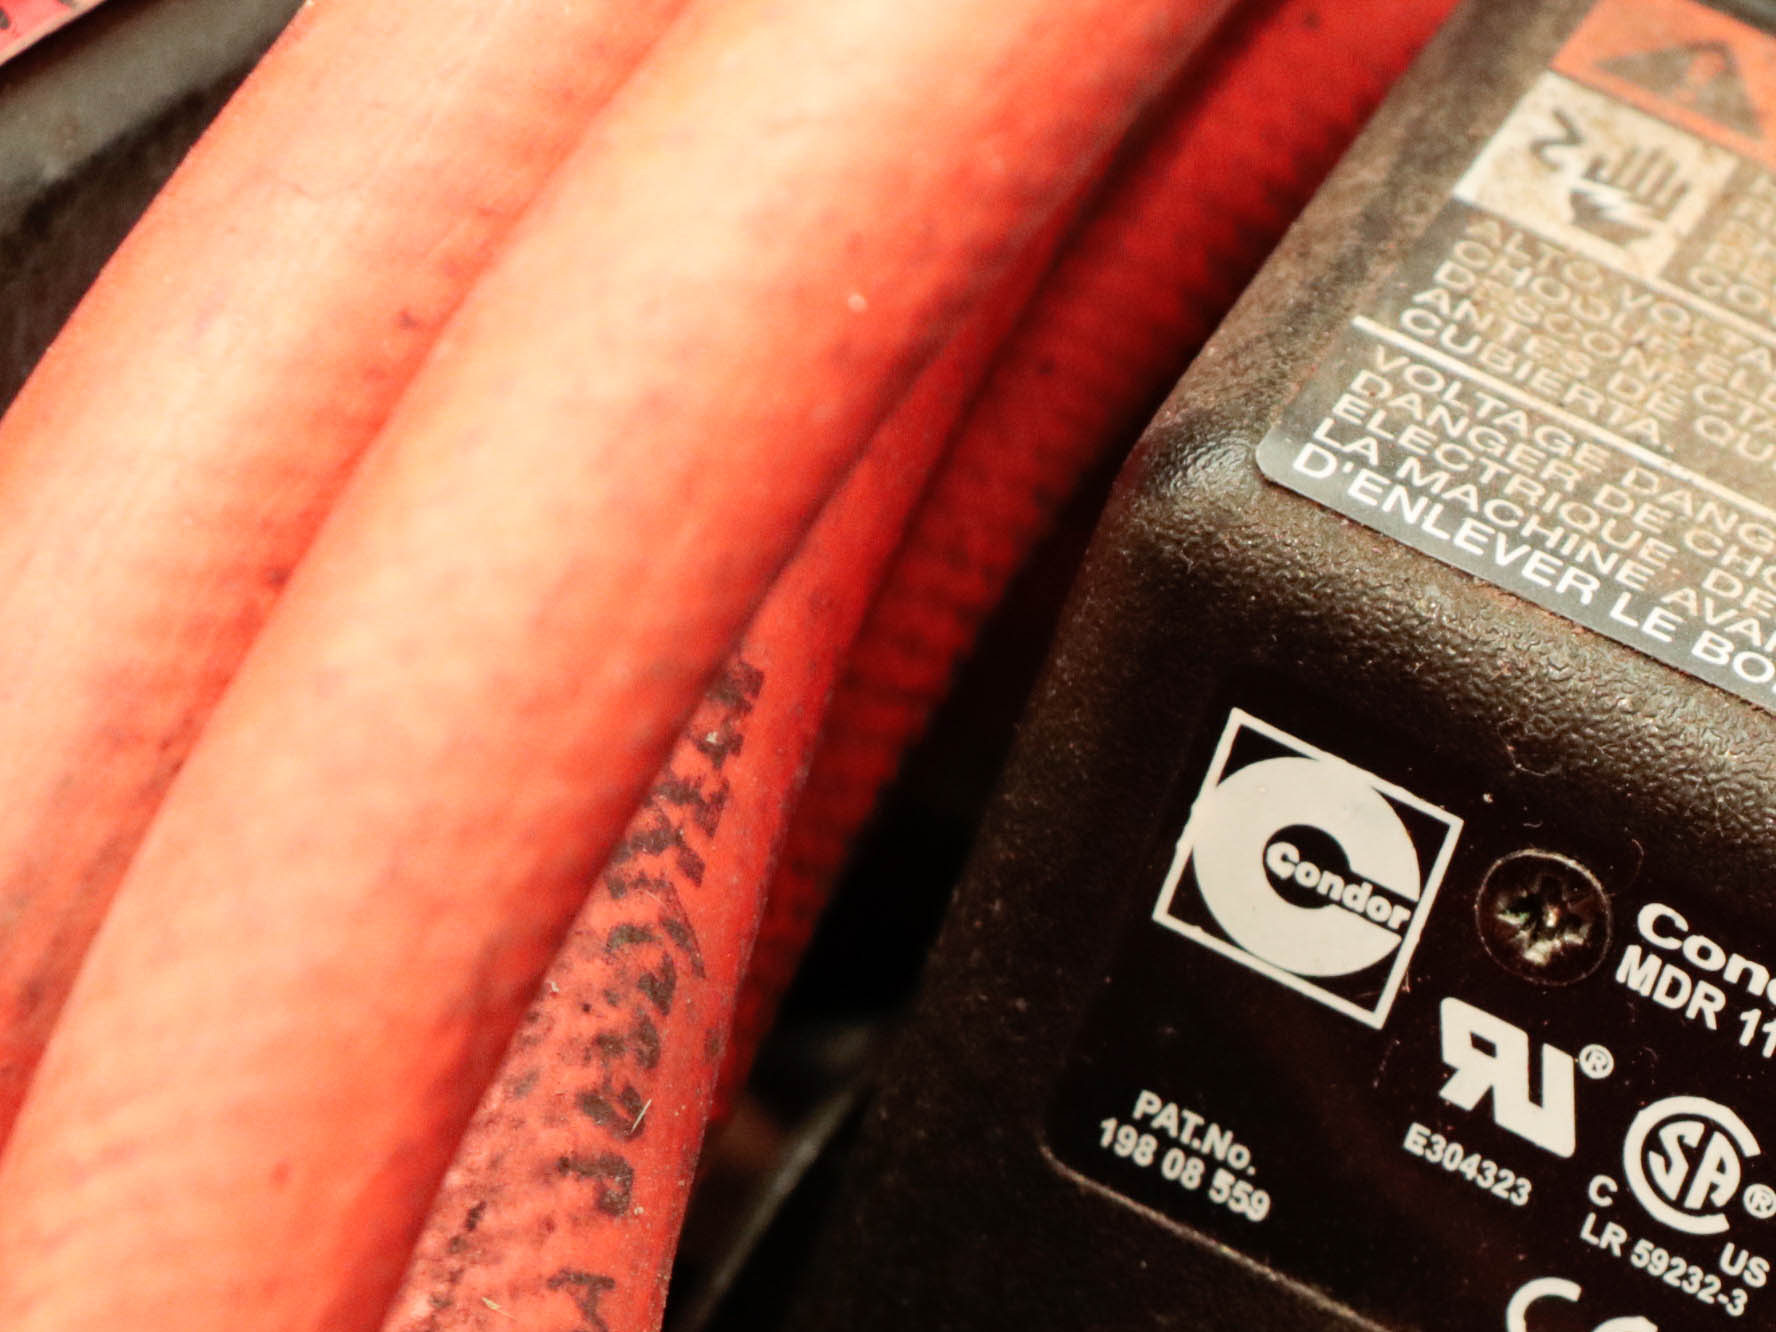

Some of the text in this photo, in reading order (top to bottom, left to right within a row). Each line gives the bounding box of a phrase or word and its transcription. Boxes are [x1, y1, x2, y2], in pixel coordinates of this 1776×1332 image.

[1460, 212, 1610, 296] ALTO
[1391, 301, 1687, 458] CUBIERTA.
[1411, 279, 1600, 383] ANTES
[1601, 369, 1688, 424] DE
[1346, 364, 1588, 496] DANGER
[1589, 480, 1675, 536] DE
[1363, 342, 1615, 477] VOLTAGE
[1309, 414, 1392, 469] LA
[1392, 452, 1660, 596] MACHINE
[1328, 389, 1696, 580] ELECTRIQUE.
[1286, 439, 1607, 609] D'ENLEVER
[1604, 589, 1687, 647] LE
[1264, 840, 1413, 935] Condor
[1614, 949, 1727, 1032] MDR
[1098, 1116, 1271, 1223] 198 08 559
[1133, 1089, 1257, 1174] PAT.No.
[1402, 1122, 1532, 1209] E304323
[1579, 1211, 1748, 1318] LR 59232-3
[1719, 1240, 1771, 1289] US
